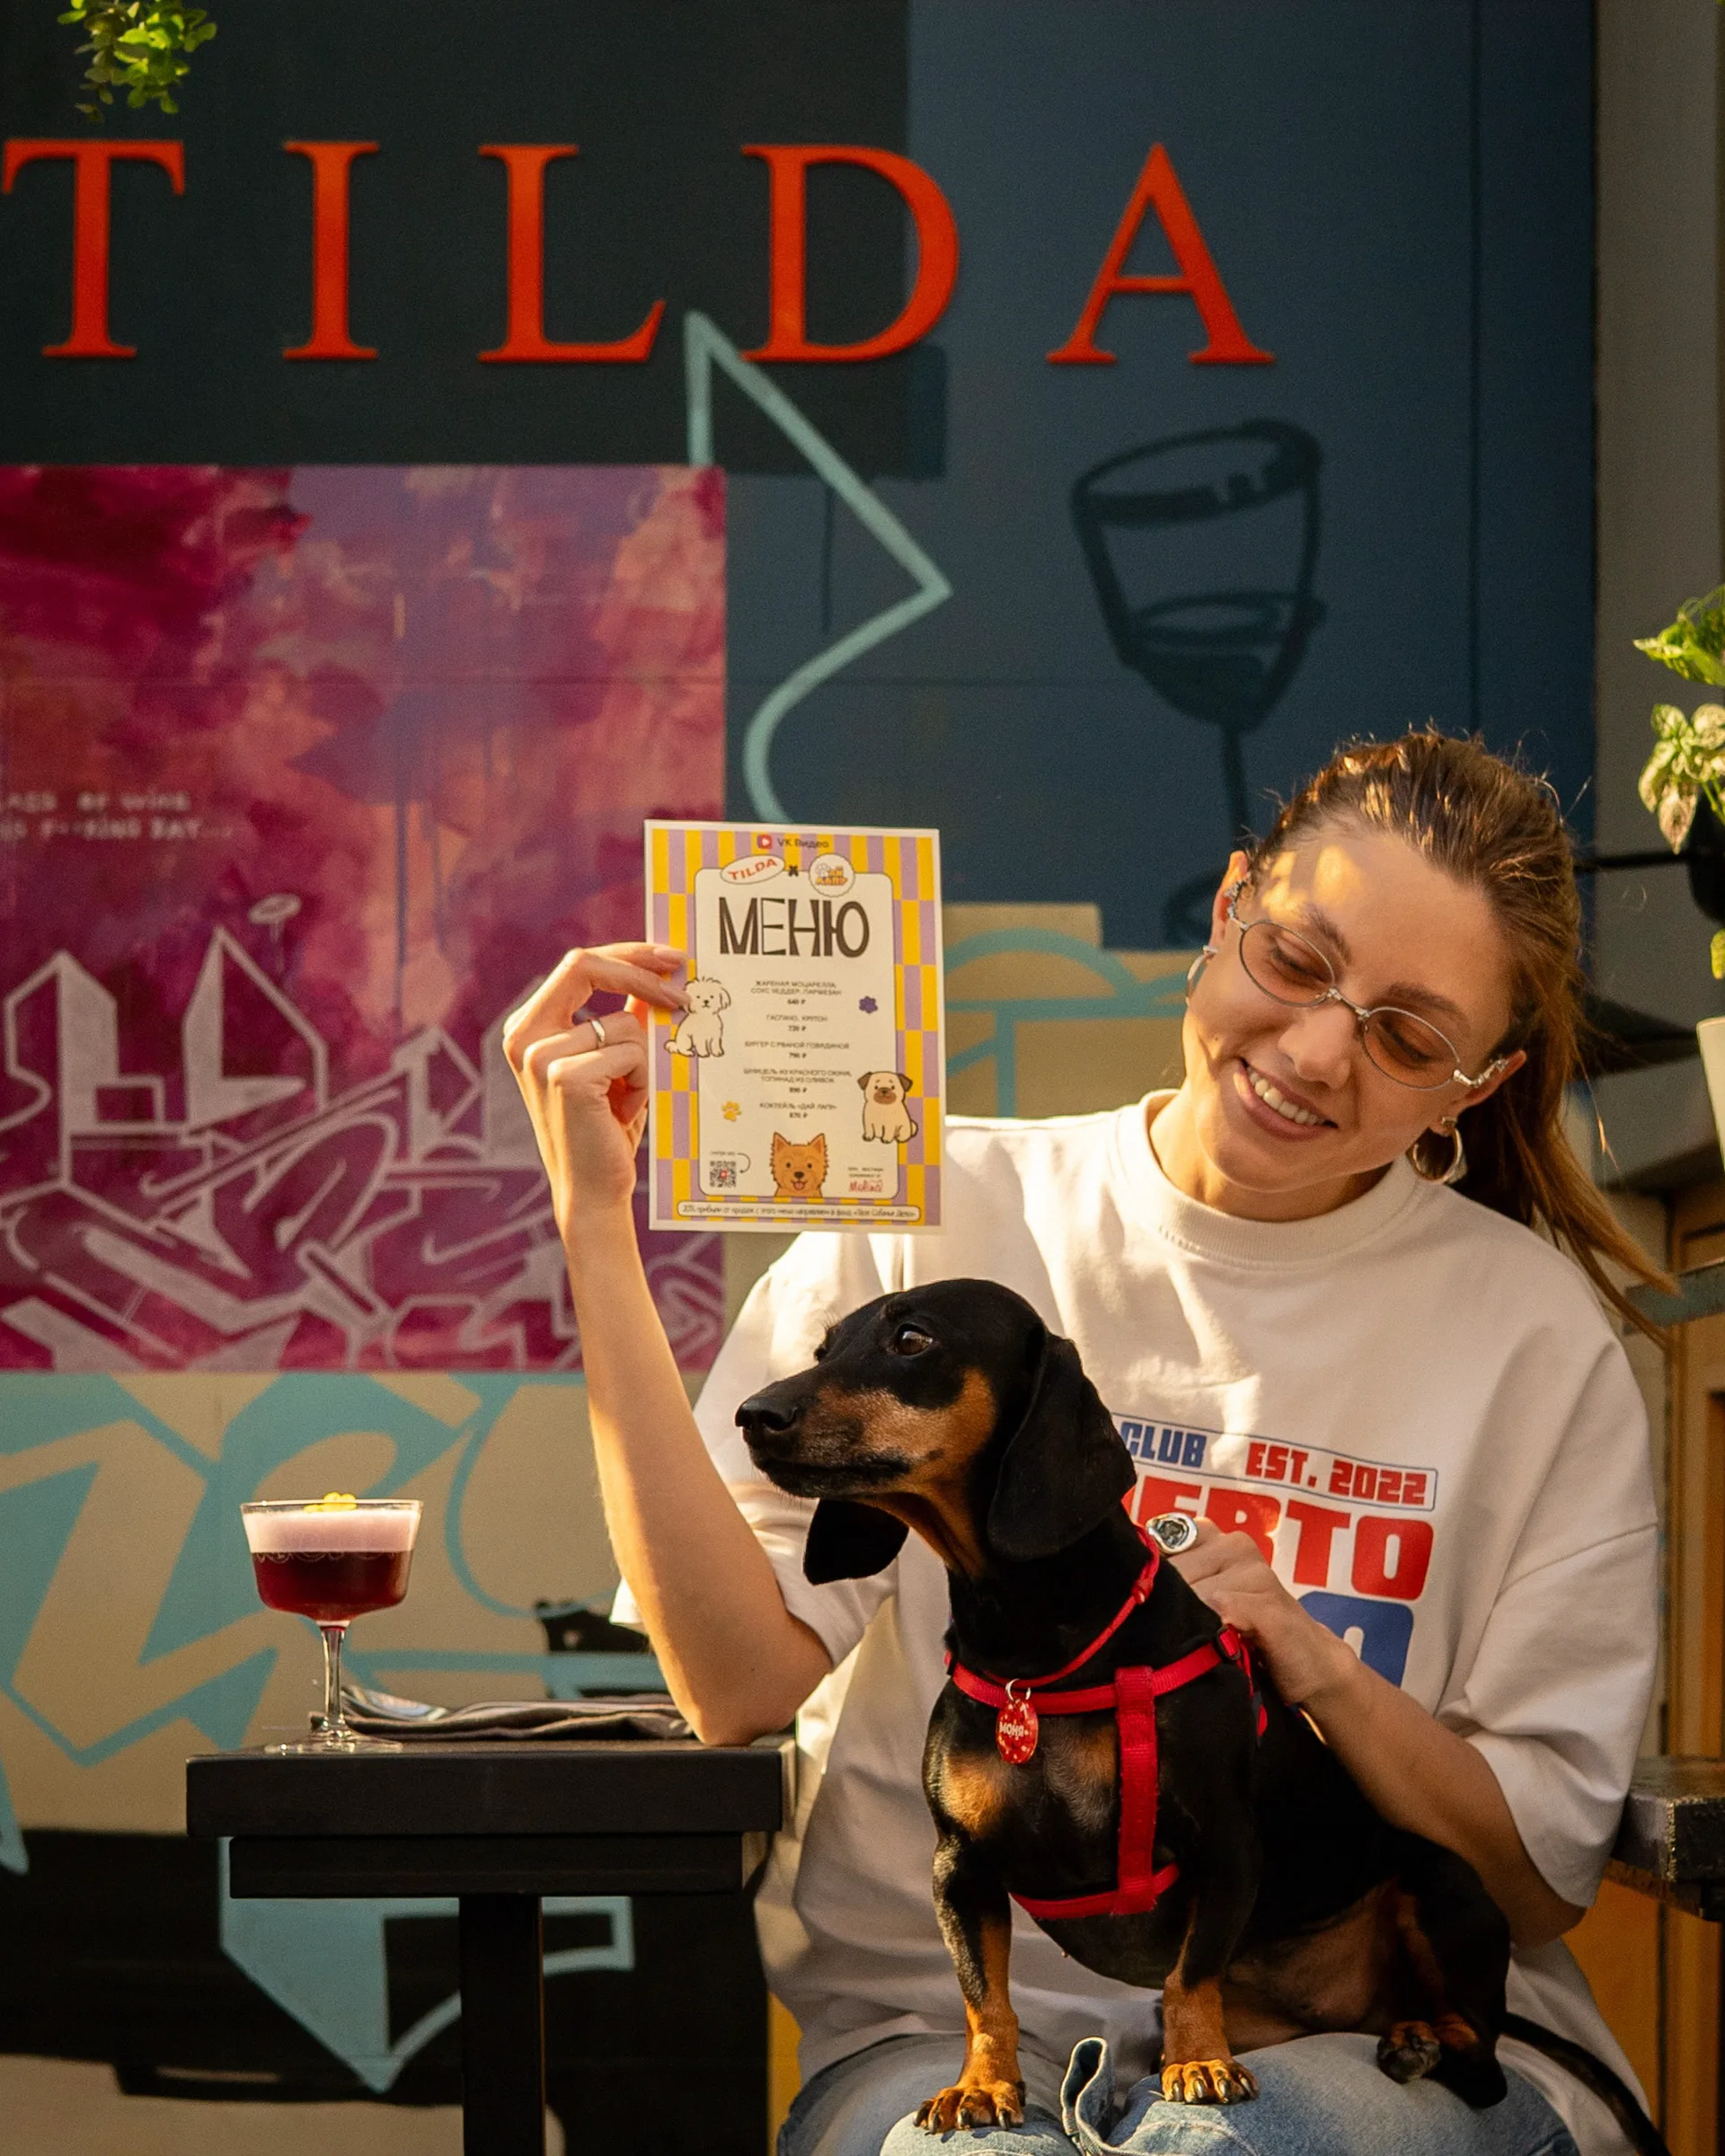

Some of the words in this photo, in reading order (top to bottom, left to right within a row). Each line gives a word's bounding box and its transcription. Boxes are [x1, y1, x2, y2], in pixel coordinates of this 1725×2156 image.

[3, 138, 1276, 366] TILDA
[728, 858, 777, 880] TILDA
[776, 838, 792, 847] VK
[719, 897, 870, 958] МЕНЮ
[1121, 1421, 1207, 1469] CLUB
[1245, 1442, 1317, 1488] EST.
[1328, 1459, 1427, 1506] 2022
